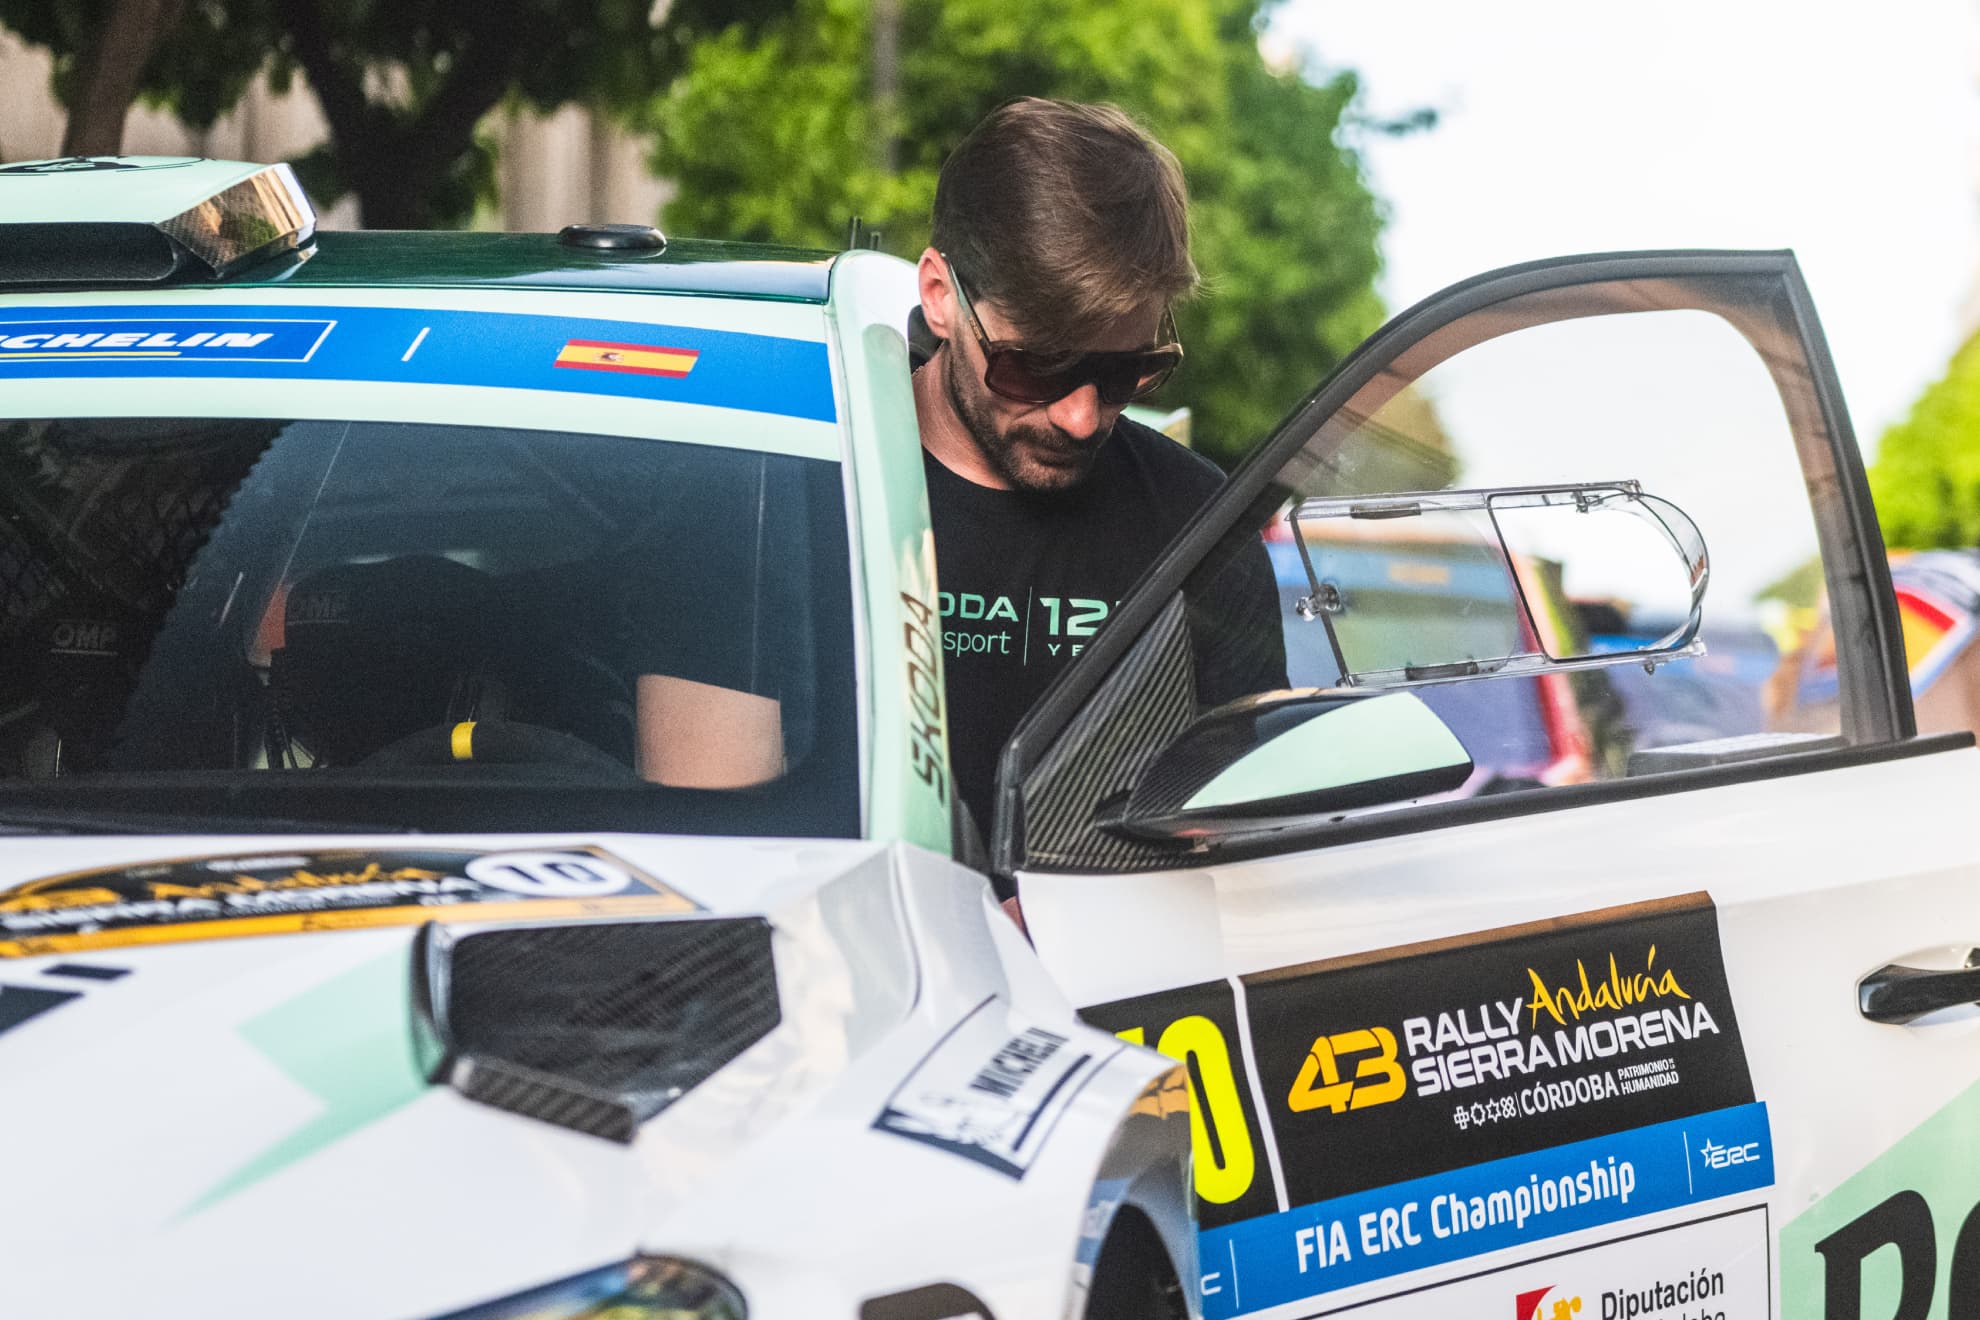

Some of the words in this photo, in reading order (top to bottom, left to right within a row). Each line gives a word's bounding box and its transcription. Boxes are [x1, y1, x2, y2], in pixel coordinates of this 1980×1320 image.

[0, 333, 274, 348] CHELIN
[53, 623, 117, 649] OMP
[1039, 597, 1120, 636] 12
[941, 630, 1011, 657] sport
[1402, 997, 1524, 1057] RALLY
[1524, 943, 1692, 1030] Andalucía
[1288, 1026, 1407, 1114] 43
[1411, 1034, 1557, 1097] SIERRA
[1554, 1002, 1720, 1067] MORENA
[1617, 1058, 1669, 1081] PATRIMONIO
[1115, 1015, 1254, 1204] 0
[1520, 1071, 1620, 1116] CÓRDOBA
[1620, 1070, 1680, 1096] HUMANIDAD
[1711, 1141, 1760, 1169] ERC
[1295, 1220, 1352, 1273] FIA
[1359, 1202, 1422, 1255] ERC
[1430, 1156, 1636, 1239] Championship
[1601, 1267, 1724, 1320] Diputación
